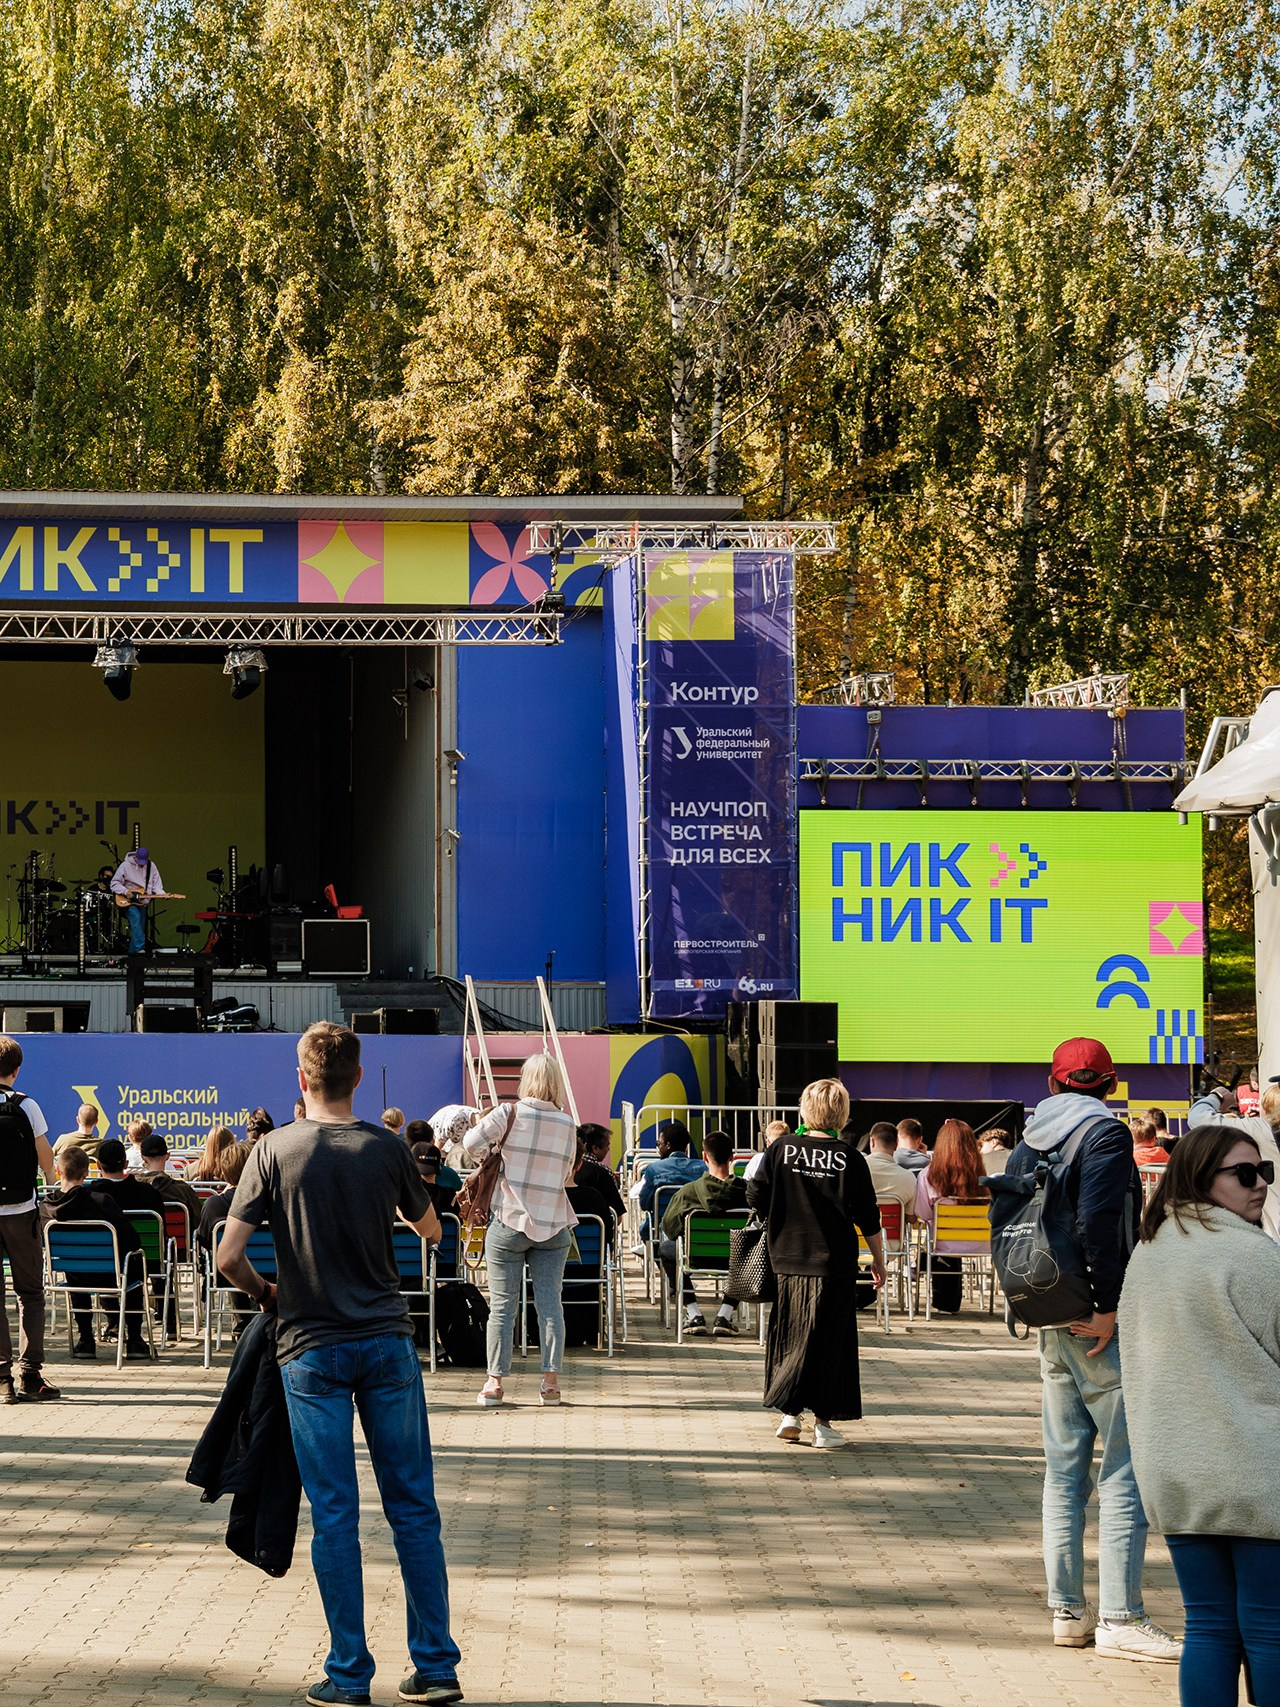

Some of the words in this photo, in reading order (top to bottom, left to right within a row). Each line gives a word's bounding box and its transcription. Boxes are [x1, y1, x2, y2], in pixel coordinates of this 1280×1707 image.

[189, 527, 264, 593] IT
[670, 681, 759, 705] Контур
[696, 727, 752, 740] Уральский
[696, 738, 770, 752] федеральный
[696, 750, 763, 761] университет
[95, 801, 140, 834] IT
[670, 801, 767, 817] НАУЧПОП
[670, 825, 762, 840] ВСТРЕЧА
[670, 849, 714, 866] ДЛЯ
[720, 849, 771, 863] ВСЕХ
[832, 842, 971, 887] ПИК
[832, 897, 972, 942] НИК
[990, 898, 1048, 942] IT
[738, 976, 774, 994] 66.RU
[117, 1085, 219, 1108] Уральский
[783, 1144, 847, 1171] PARIS
